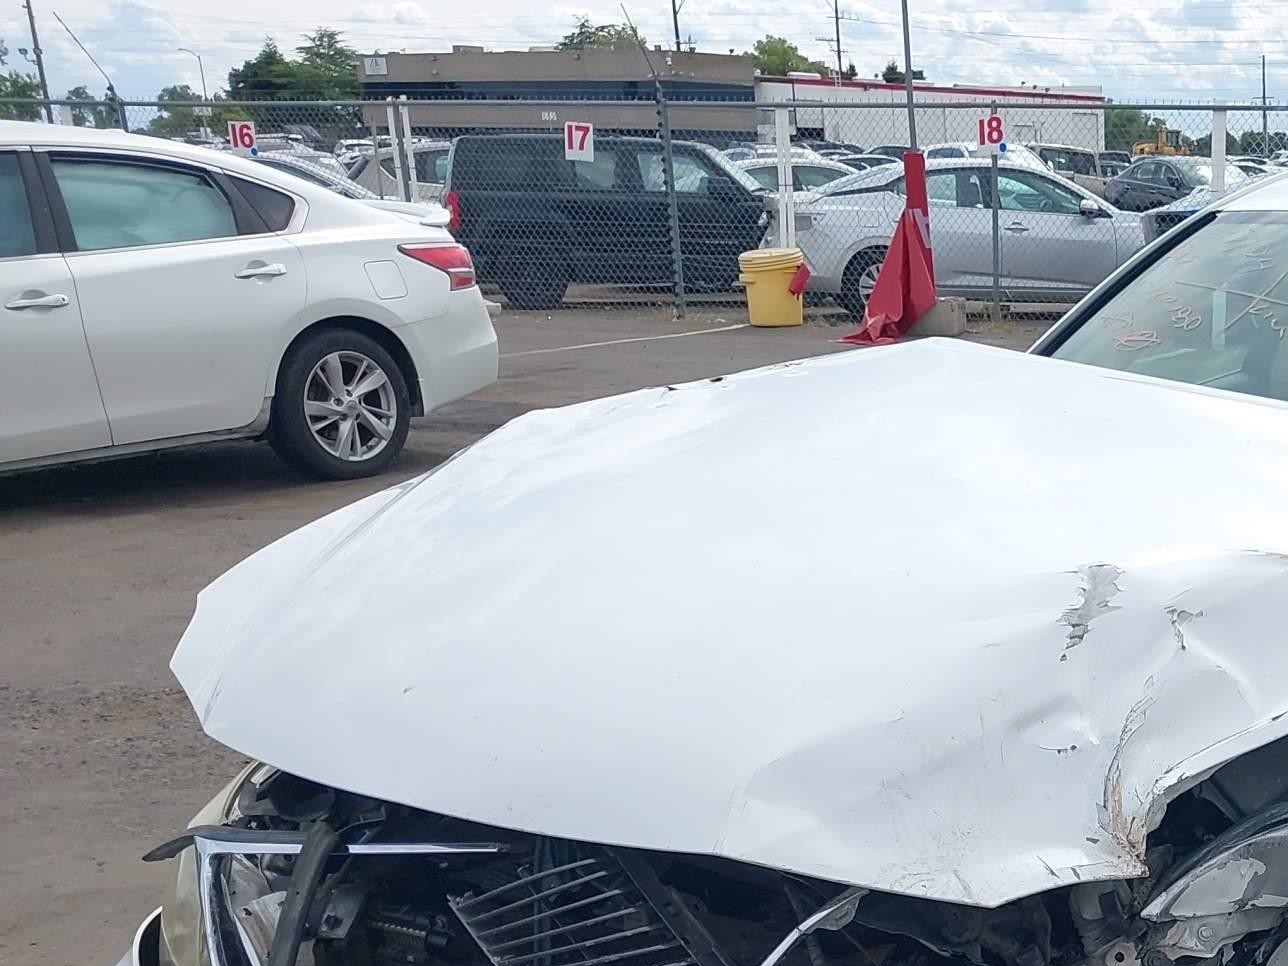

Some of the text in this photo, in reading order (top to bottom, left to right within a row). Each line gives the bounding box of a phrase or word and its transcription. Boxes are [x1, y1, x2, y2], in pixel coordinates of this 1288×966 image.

[231, 124, 254, 148] 16
[567, 124, 590, 151] 17
[979, 116, 1003, 145] 18
